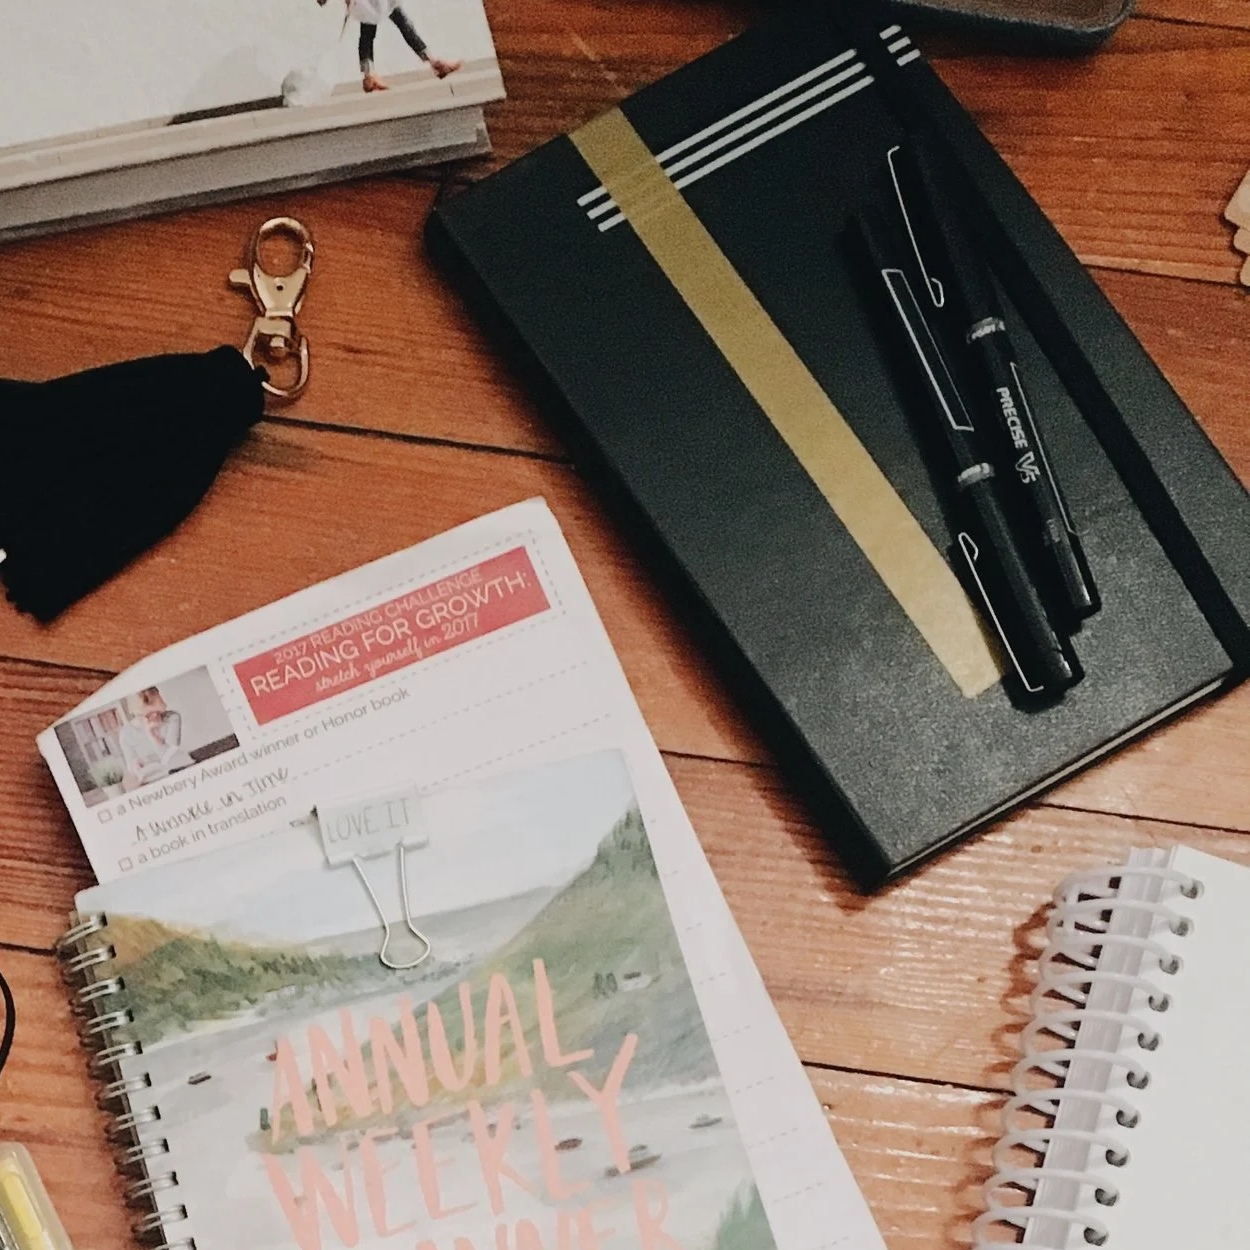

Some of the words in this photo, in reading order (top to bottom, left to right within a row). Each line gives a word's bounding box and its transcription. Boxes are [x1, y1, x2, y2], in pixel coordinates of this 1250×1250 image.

[996, 386, 1028, 448] PRECISE
[1015, 450, 1040, 484] V5
[250, 638, 360, 697] READING
[361, 617, 412, 653] FOR
[416, 570, 531, 627] GROWTH:
[274, 642, 308, 665] 2017
[311, 609, 382, 648] READING
[385, 568, 484, 618] CHALLENGE
[315, 661, 360, 692] stretch
[364, 636, 425, 679] yourself
[423, 633, 443, 650] in
[440, 611, 482, 643] 2017
[116, 805, 128, 817] a
[128, 775, 199, 812] Newbery
[200, 752, 249, 783] Award
[251, 732, 302, 760] winner
[303, 726, 320, 740] or
[321, 706, 370, 734] Honor
[370, 685, 411, 713] book
[137, 850, 149, 865] a
[149, 834, 190, 862] book
[190, 826, 208, 844] in
[208, 794, 288, 836] translation
[324, 805, 381, 846] LOVE
[384, 796, 411, 830] IT
[271, 957, 595, 1146] ANNUAL
